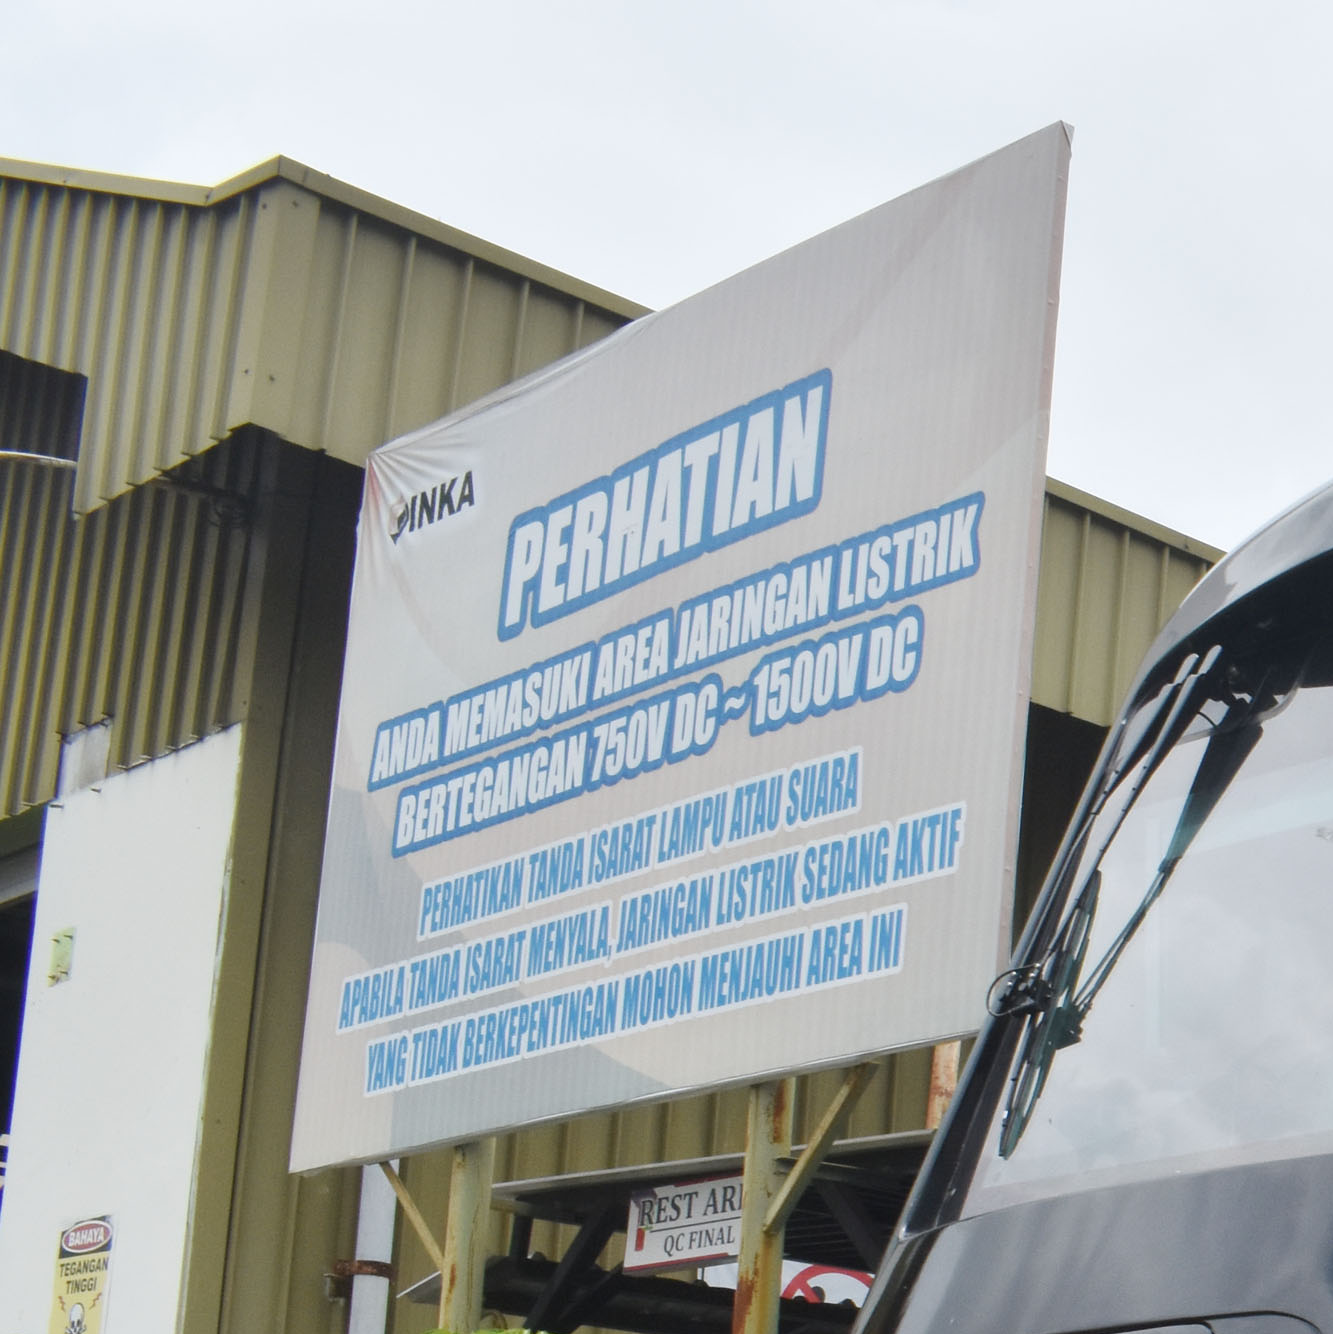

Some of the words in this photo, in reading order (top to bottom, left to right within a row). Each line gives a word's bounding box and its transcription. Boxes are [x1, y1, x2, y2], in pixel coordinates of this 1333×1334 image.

[501, 379, 827, 633] PERHATIAN
[370, 708, 441, 785] ANDA
[443, 650, 592, 758] MEMASUKI
[592, 617, 670, 702] AREA
[673, 555, 833, 670] JARINGAN
[836, 502, 979, 611] LISTRIK
[395, 730, 588, 849] BERTEGANGAN
[590, 700, 671, 783] 750V
[671, 682, 719, 754] DC
[753, 633, 863, 726] 1500V
[866, 615, 919, 691] DC
[338, 965, 405, 1031] APABILA
[407, 948, 463, 1011] TANDA
[463, 929, 528, 997] ISARAT
[526, 904, 612, 979] MENYALA,
[616, 874, 715, 954] JARINGAN
[715, 851, 800, 926] LISTRIK
[801, 826, 890, 905] SEDANG
[892, 806, 963, 882] AKTIF
[419, 857, 525, 937] PERHATIKAN
[526, 837, 587, 904] TANDA
[587, 814, 657, 886] ISARAT
[657, 791, 728, 864] LAMPU
[728, 774, 784, 842] ATAU
[785, 752, 860, 827] SUARA
[366, 1034, 409, 1094] YANG
[409, 1021, 461, 1082] TIDAK
[461, 980, 620, 1070] BERKEPENTINGAN
[620, 959, 697, 1031] MOHON
[697, 932, 806, 1012] MENJAUHI
[805, 918, 865, 988] AREA
[867, 908, 905, 974] INI
[59, 1256, 109, 1278] TEGANGAN
[65, 1278, 97, 1295] TINGGI
[67, 1225, 105, 1247] BAHAYA
[638, 1190, 698, 1227] REST
[663, 1234, 684, 1257] QC
[688, 1226, 735, 1250] FINAL
